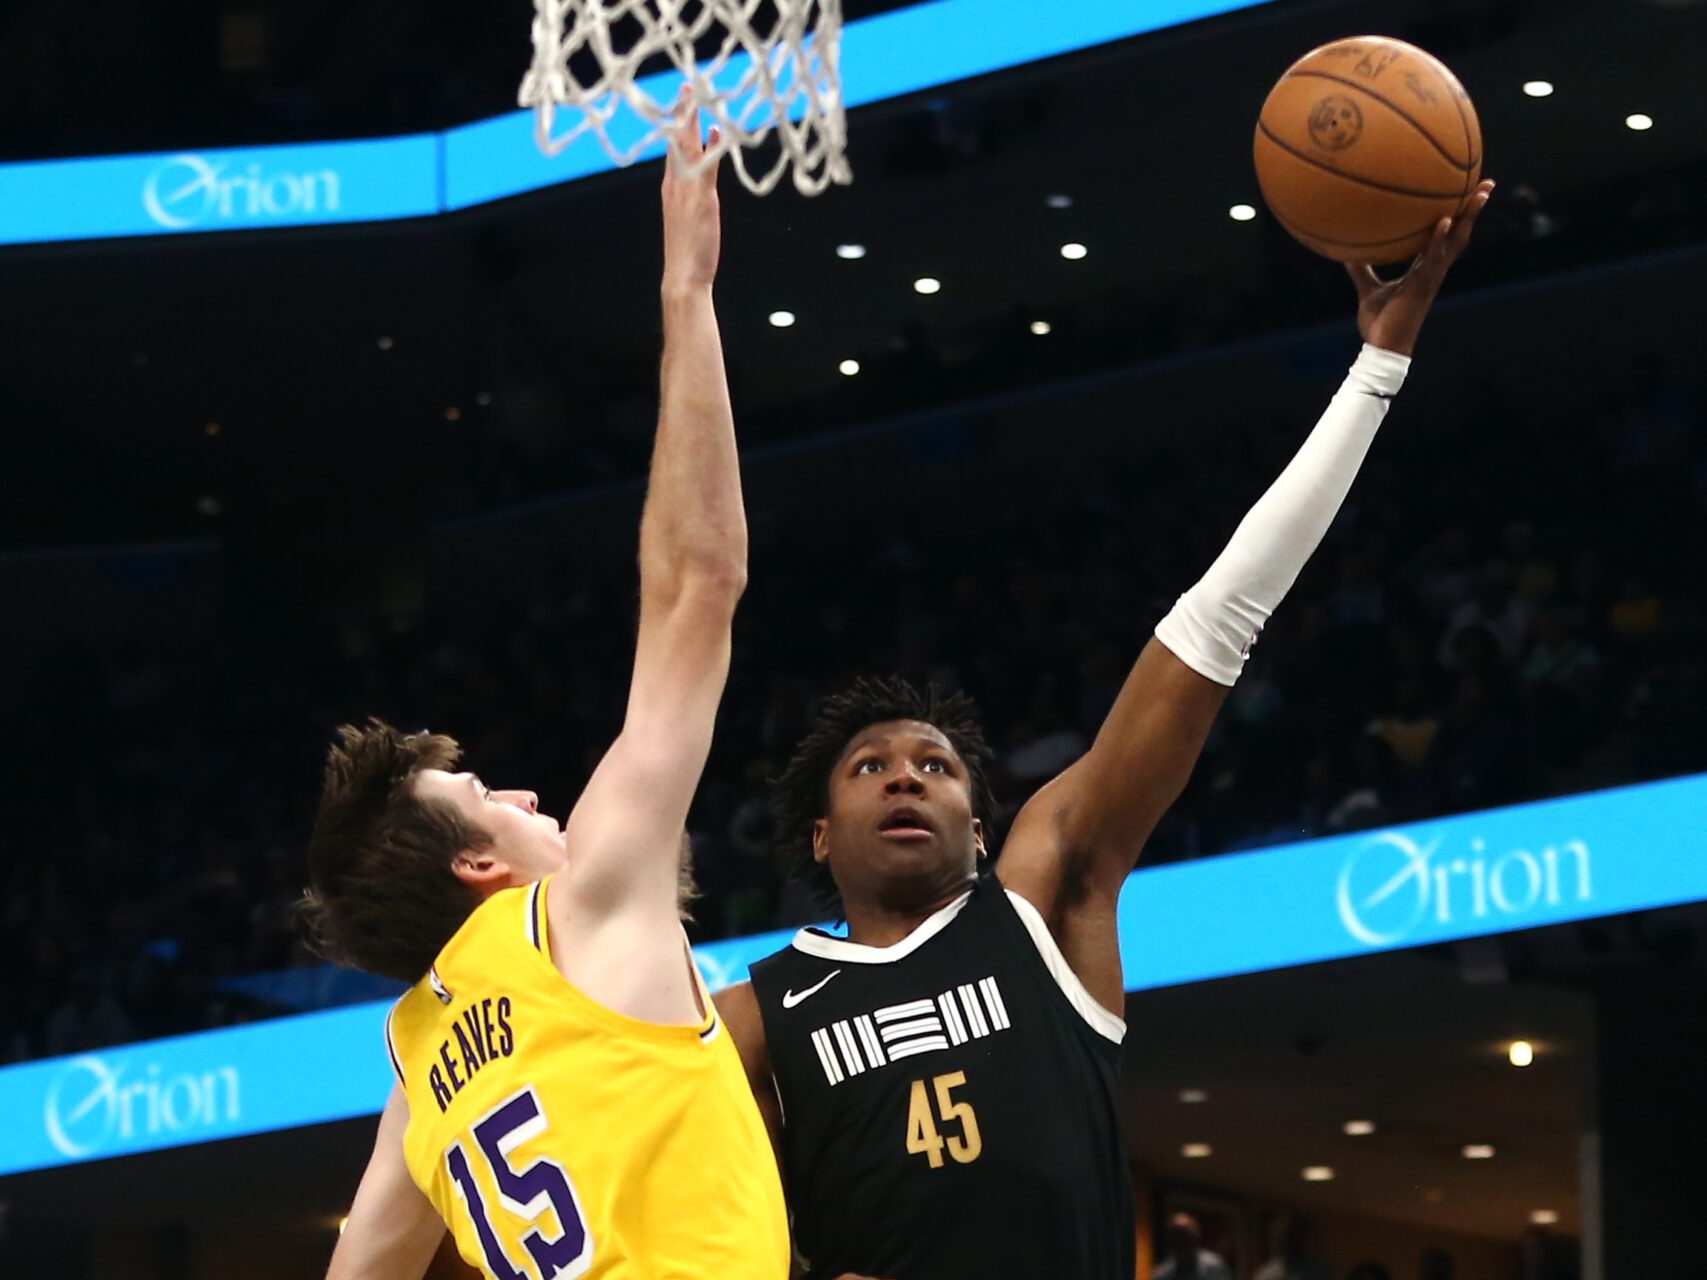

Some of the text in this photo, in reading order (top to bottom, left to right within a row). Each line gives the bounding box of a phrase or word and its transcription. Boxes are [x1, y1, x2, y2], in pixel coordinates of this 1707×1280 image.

[143, 154, 340, 228] Orion
[1336, 831, 1593, 945] Orion
[44, 1054, 241, 1158] Orion
[428, 996, 514, 1114] REAVES
[905, 1070, 982, 1169] 45
